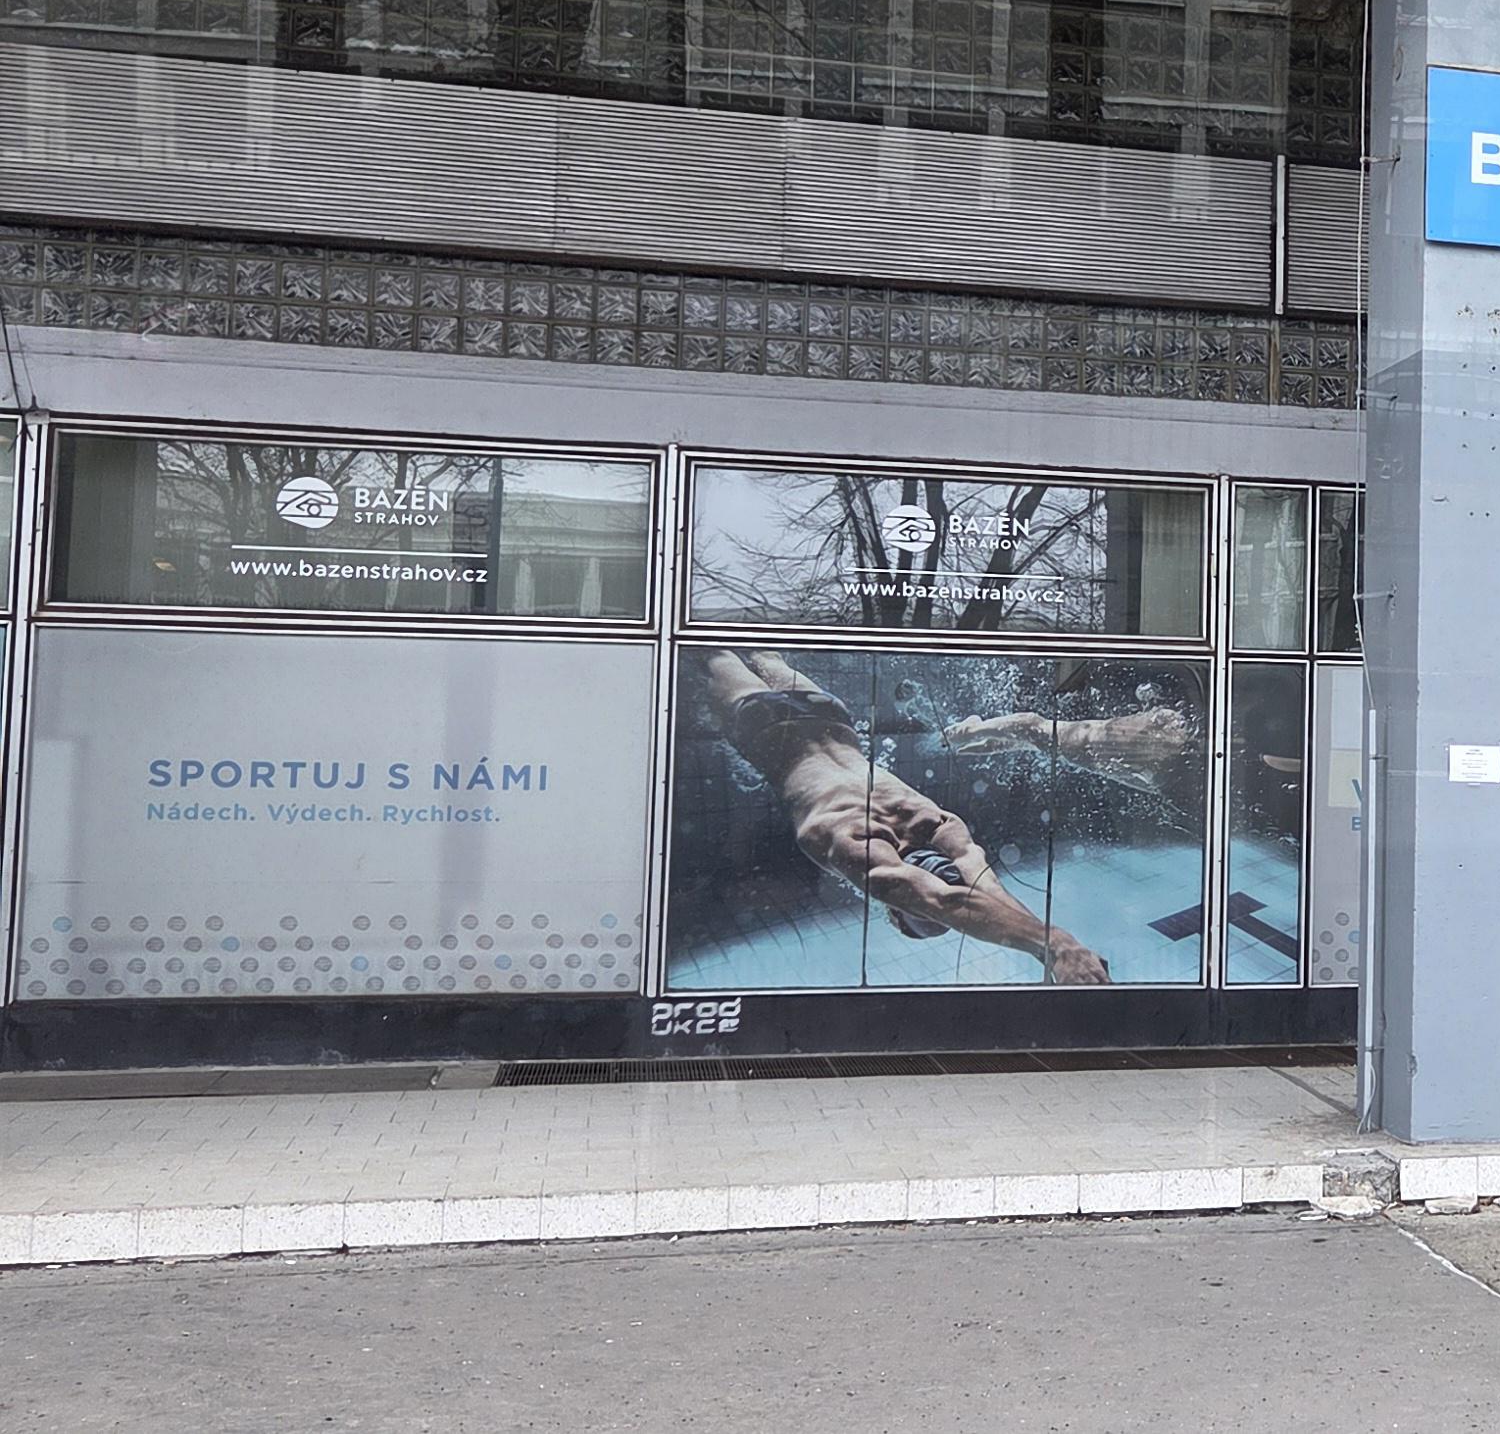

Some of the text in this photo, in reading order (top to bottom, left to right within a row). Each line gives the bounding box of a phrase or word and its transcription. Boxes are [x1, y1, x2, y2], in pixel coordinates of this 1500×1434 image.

[354, 511, 440, 527] STRAHOV
[948, 537, 1022, 551] STRAHOV
[231, 559, 488, 583] www.bazenstrahov.cz
[843, 582, 1065, 603] www.bazenstrahov.cz
[147, 756, 549, 792] SPORTUJ S NÁMI
[146, 802, 502, 825] Nádech. Výdech. Rychlost.
